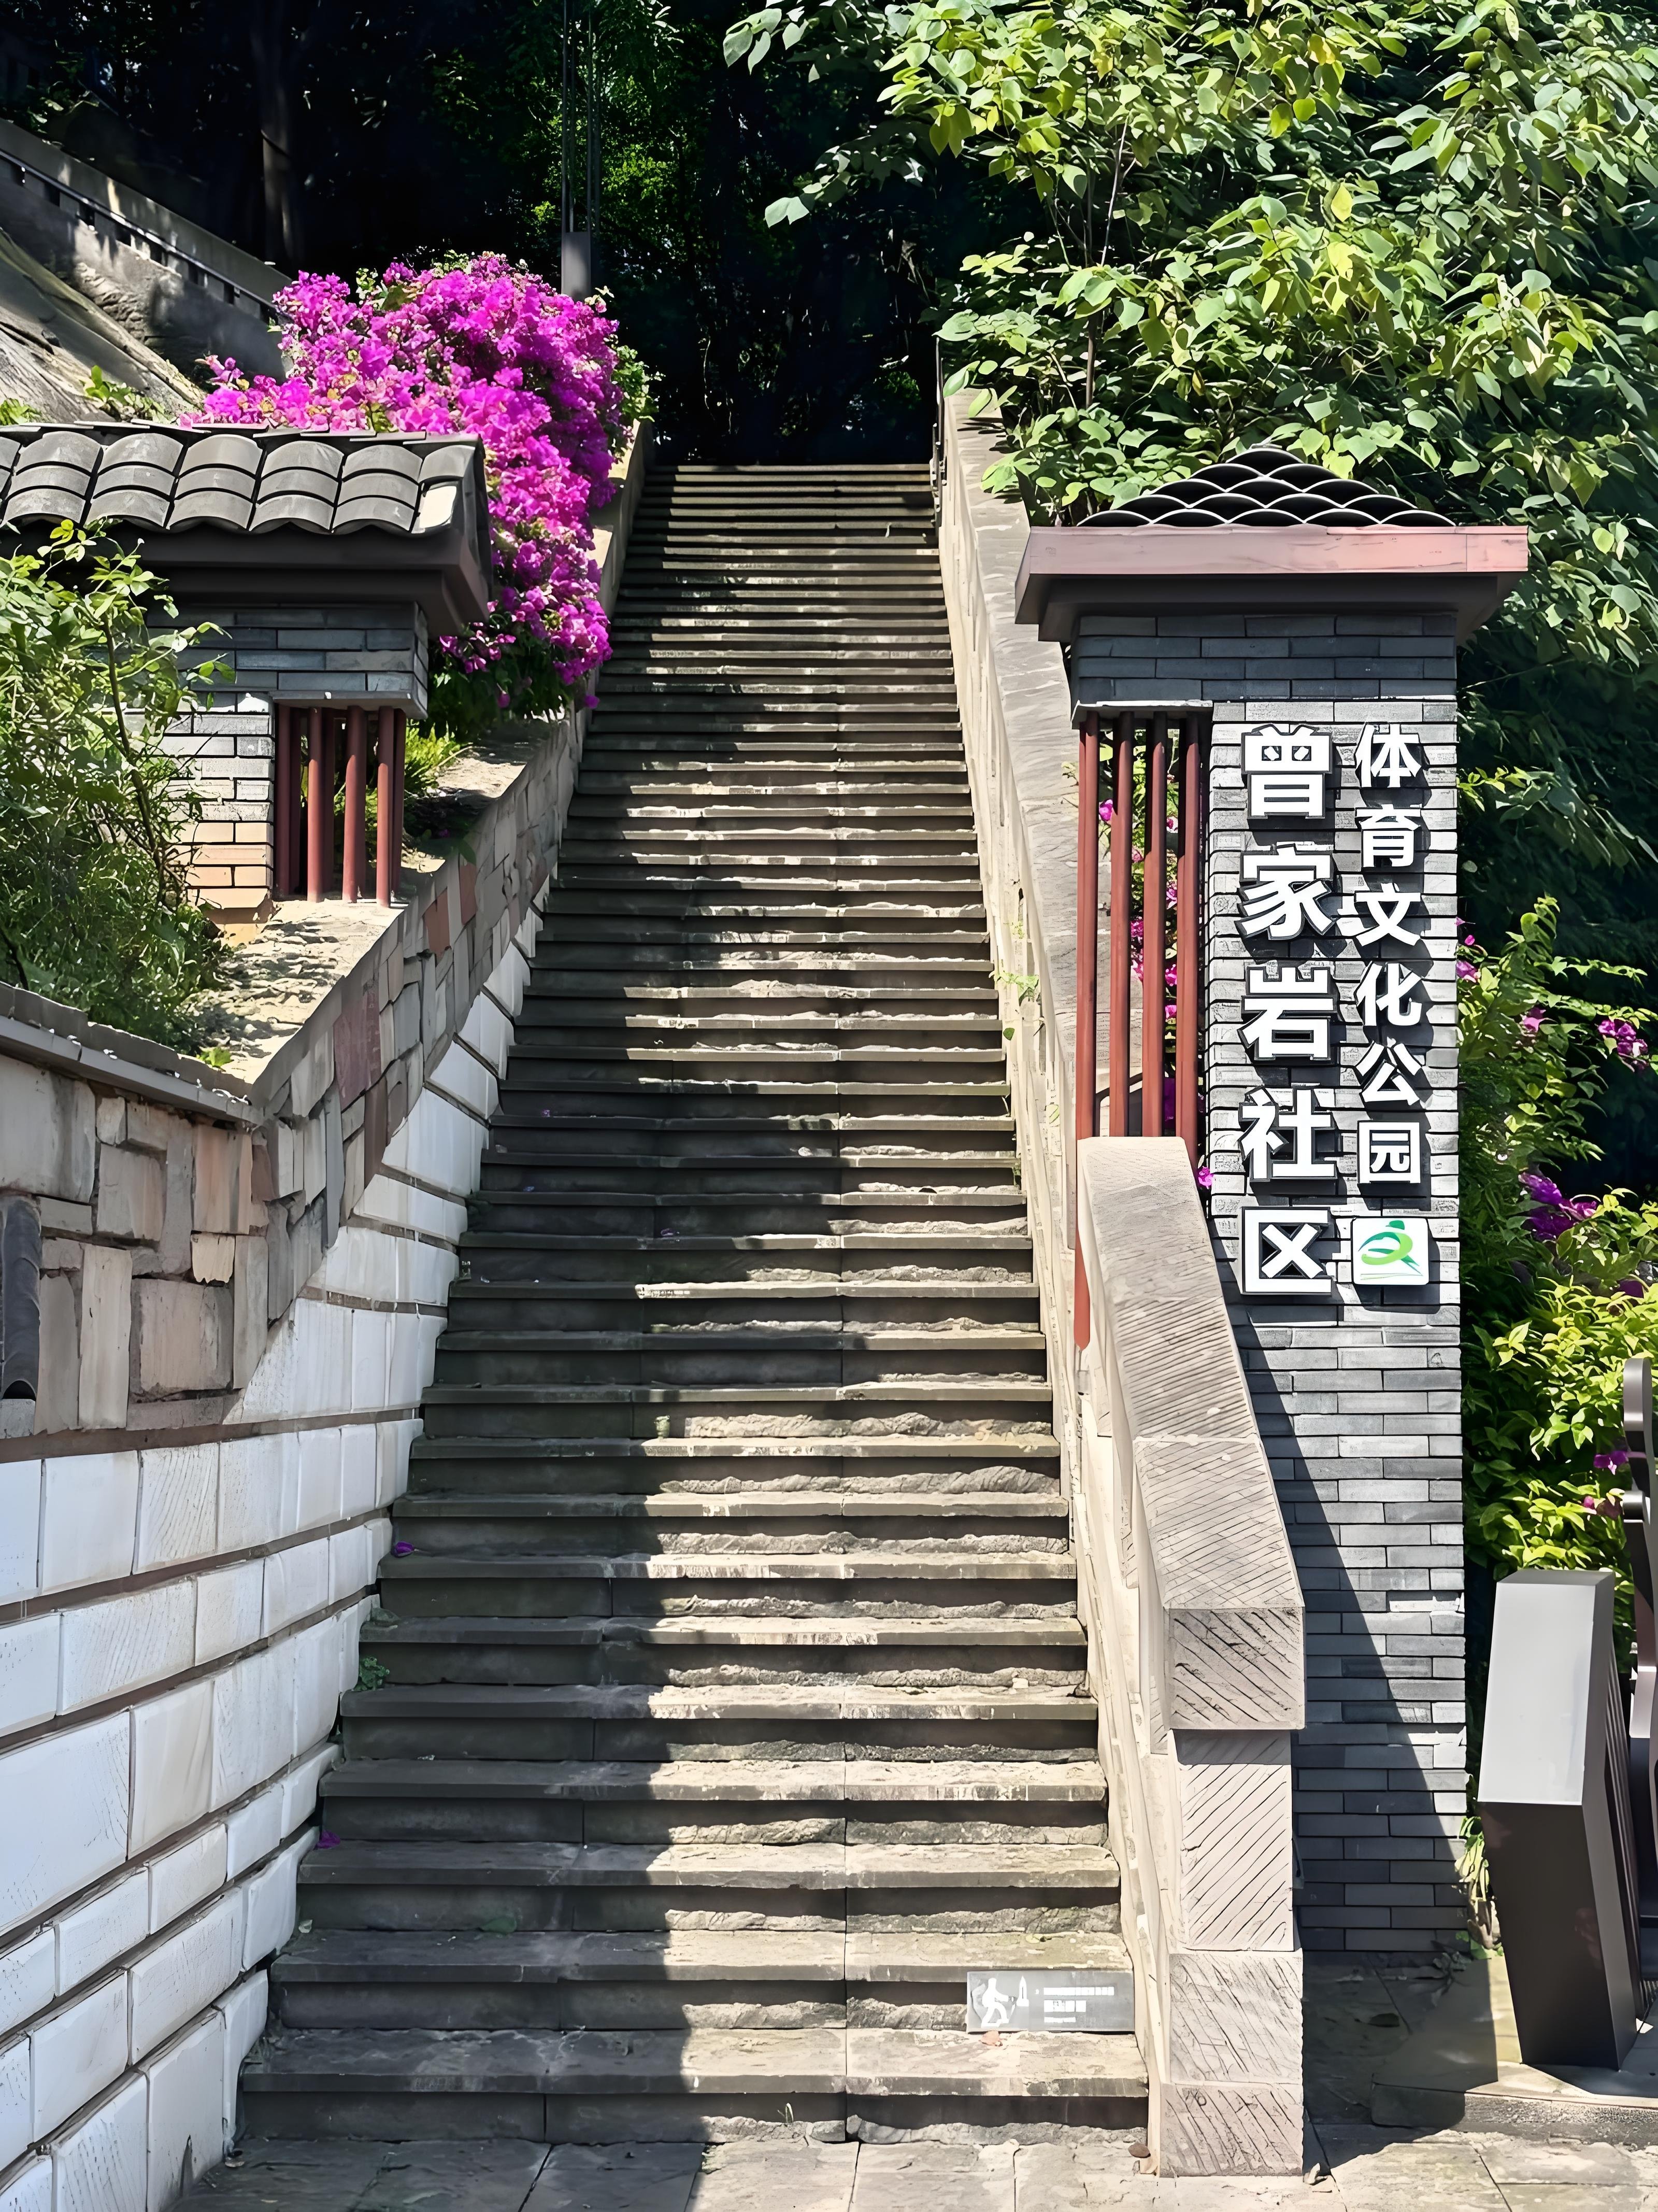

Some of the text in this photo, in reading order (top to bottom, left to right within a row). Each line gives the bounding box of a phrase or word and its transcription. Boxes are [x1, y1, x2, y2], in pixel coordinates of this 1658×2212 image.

[1240, 724, 1337, 1294] 曾家岩社区
[1354, 723, 1423, 1185] 体育文化公园
